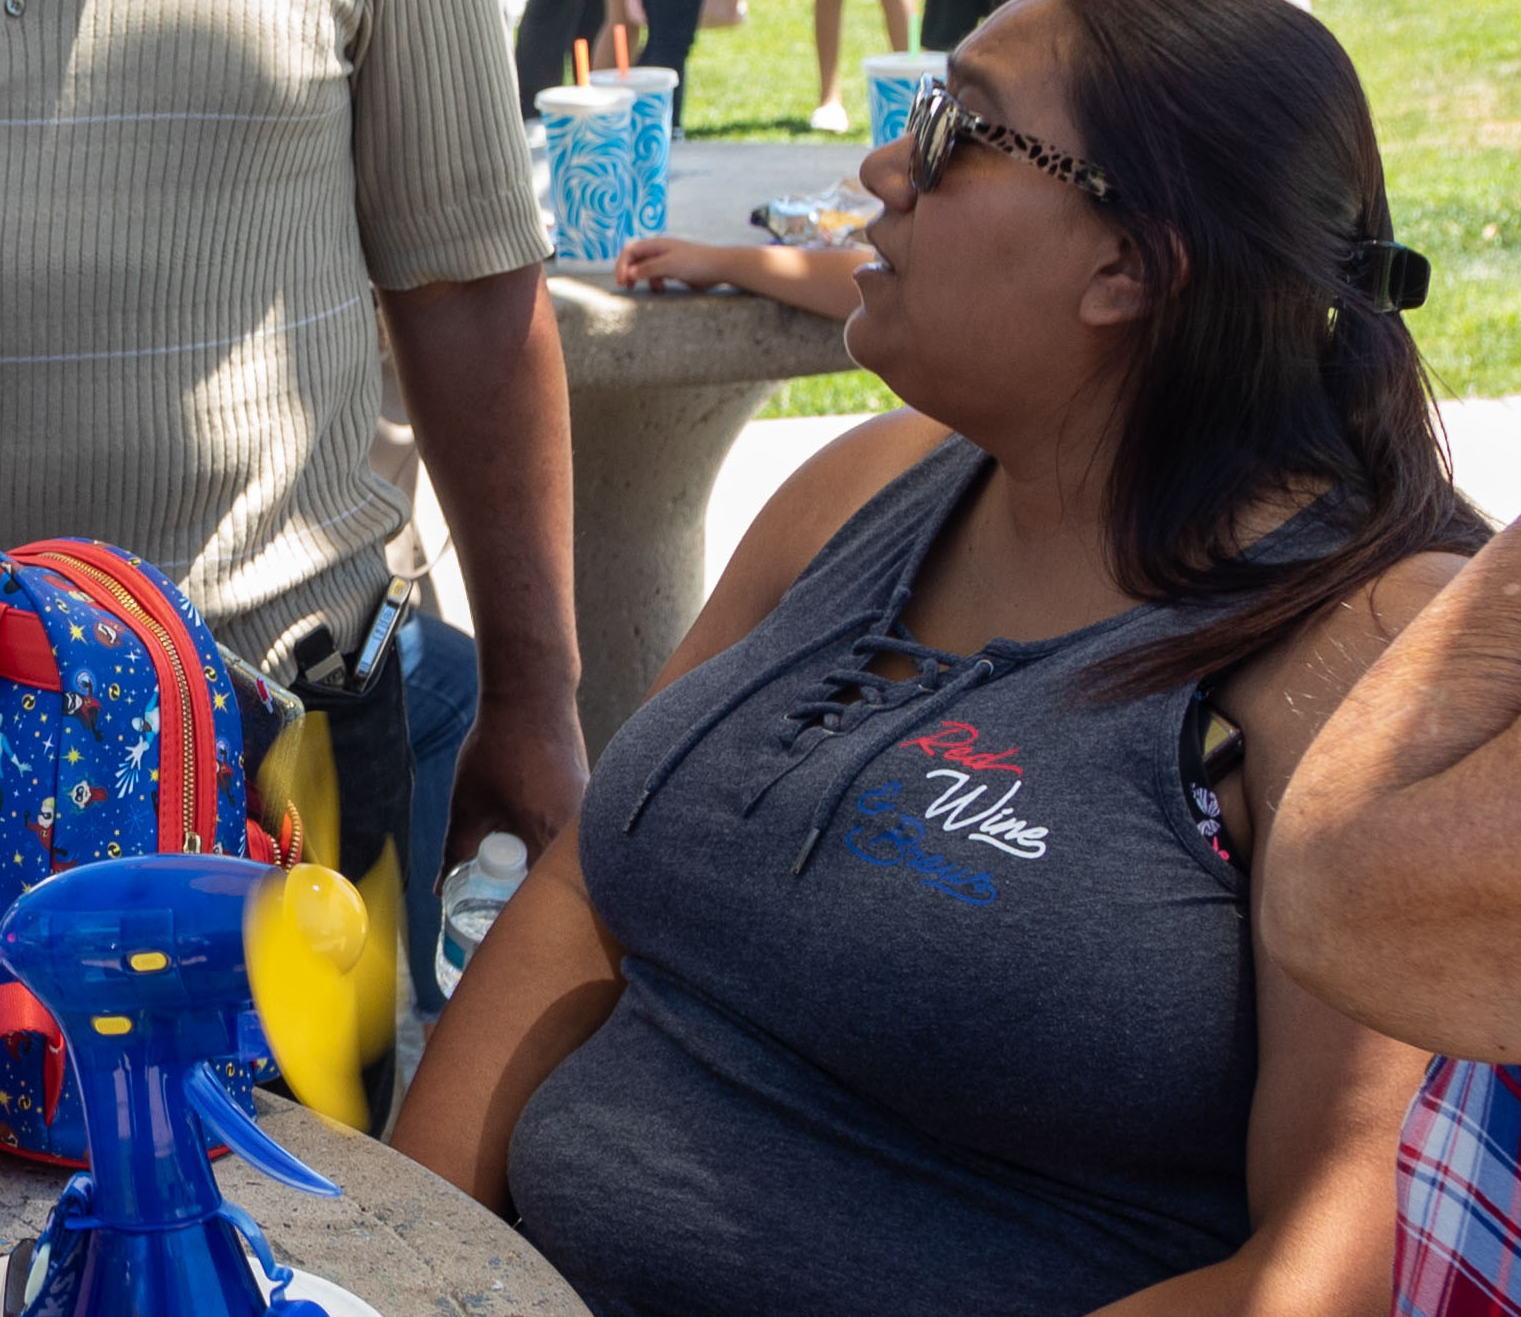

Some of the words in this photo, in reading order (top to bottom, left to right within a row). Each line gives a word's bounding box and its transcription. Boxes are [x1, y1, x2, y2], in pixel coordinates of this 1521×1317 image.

[899, 721, 1023, 776] Red
[926, 769, 1050, 859] Wine
[845, 814, 998, 906] Brews
